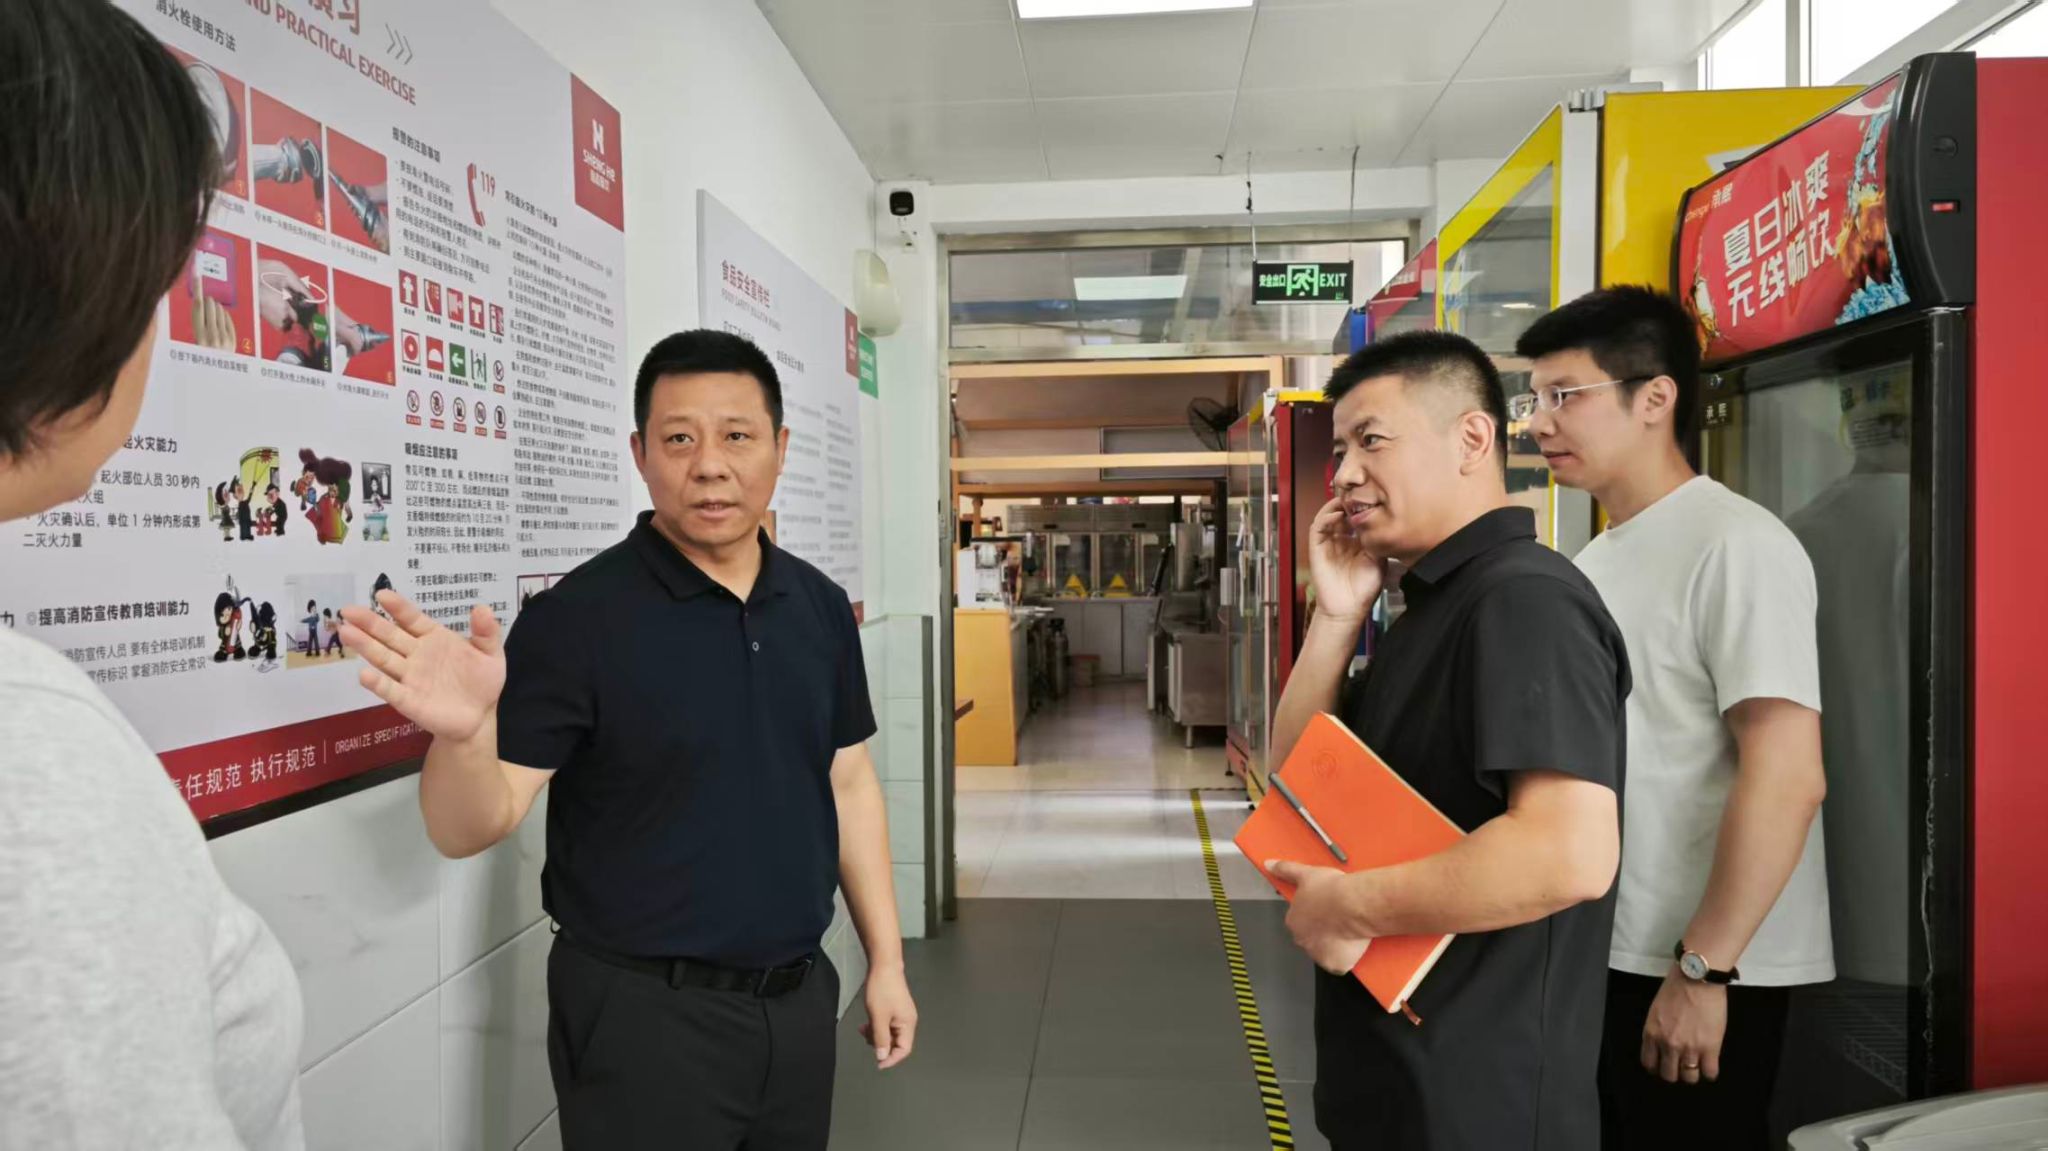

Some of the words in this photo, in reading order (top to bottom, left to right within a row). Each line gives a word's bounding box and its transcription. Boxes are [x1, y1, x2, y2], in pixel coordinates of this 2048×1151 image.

[276, 3, 356, 69] PRACTICAL
[358, 56, 416, 105] EXERCISE
[481, 170, 496, 197] 119
[1723, 150, 1829, 275] 夏日冰爽
[1728, 209, 1838, 326] 无线畅饮
[1259, 273, 1286, 288] 安全出口
[1319, 273, 1348, 288] EXIT
[100, 469, 163, 487] 起火部位人员
[165, 474, 179, 487] 30
[181, 474, 200, 489] 秒内
[107, 512, 129, 528] 单位
[143, 513, 201, 529] 分钟内形成第
[23, 533, 83, 548] 二灭火力量
[39, 599, 189, 627] 提高消防宣传教育培训能力
[130, 635, 206, 657] 要有全体培训机制
[131, 656, 206, 678] 掌握消防安全常识
[250, 745, 317, 783] 执行规范
[335, 733, 371, 754] ORGANIZE
[374, 722, 422, 745] SPECIFICATI
